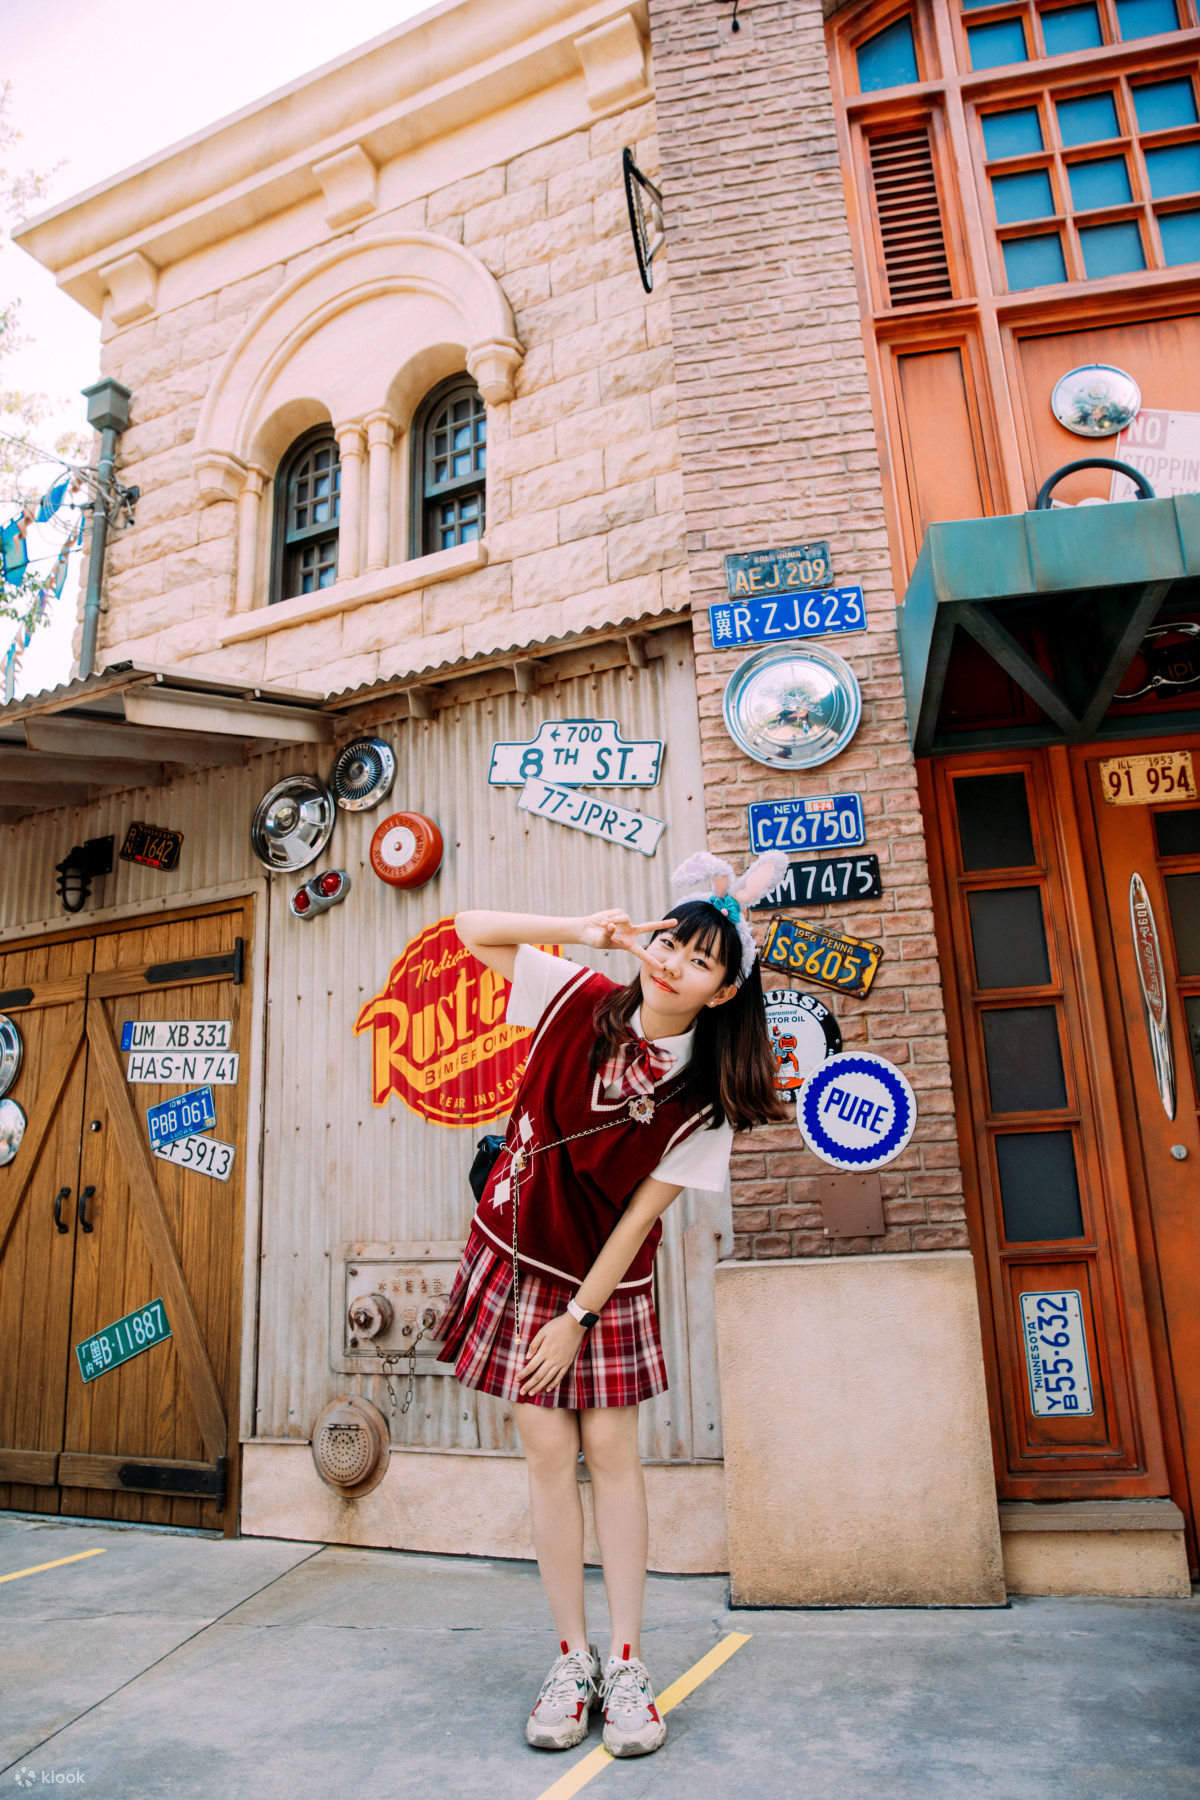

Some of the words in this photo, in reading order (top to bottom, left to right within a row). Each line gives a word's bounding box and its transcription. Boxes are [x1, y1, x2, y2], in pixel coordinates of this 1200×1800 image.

[1127, 414, 1161, 444] NO
[735, 563, 780, 592] AEJ
[785, 558, 825, 586] 209
[567, 726, 602, 743] 700
[593, 747, 637, 780] ST.
[1108, 771, 1134, 797] 91
[1146, 765, 1190, 794] 954
[538, 786, 643, 843] 77-JPR-2
[774, 803, 800, 815] NEV
[757, 810, 857, 848] CZ6750
[794, 927, 817, 943] 1956
[821, 937, 855, 955] PENNA
[772, 936, 862, 983] SS605
[764, 990, 828, 1021] URSE
[791, 1015, 806, 1023] OIL
[132, 1024, 156, 1047] UM
[166, 1024, 189, 1047] XB
[193, 1024, 227, 1047] 331
[130, 1056, 196, 1080] HAS-N
[203, 1057, 236, 1081] 741
[151, 1110, 178, 1140] PBB
[181, 1098, 210, 1128] 061
[823, 1087, 889, 1135] PURE
[1027, 1321, 1044, 1389] MINNESOTA
